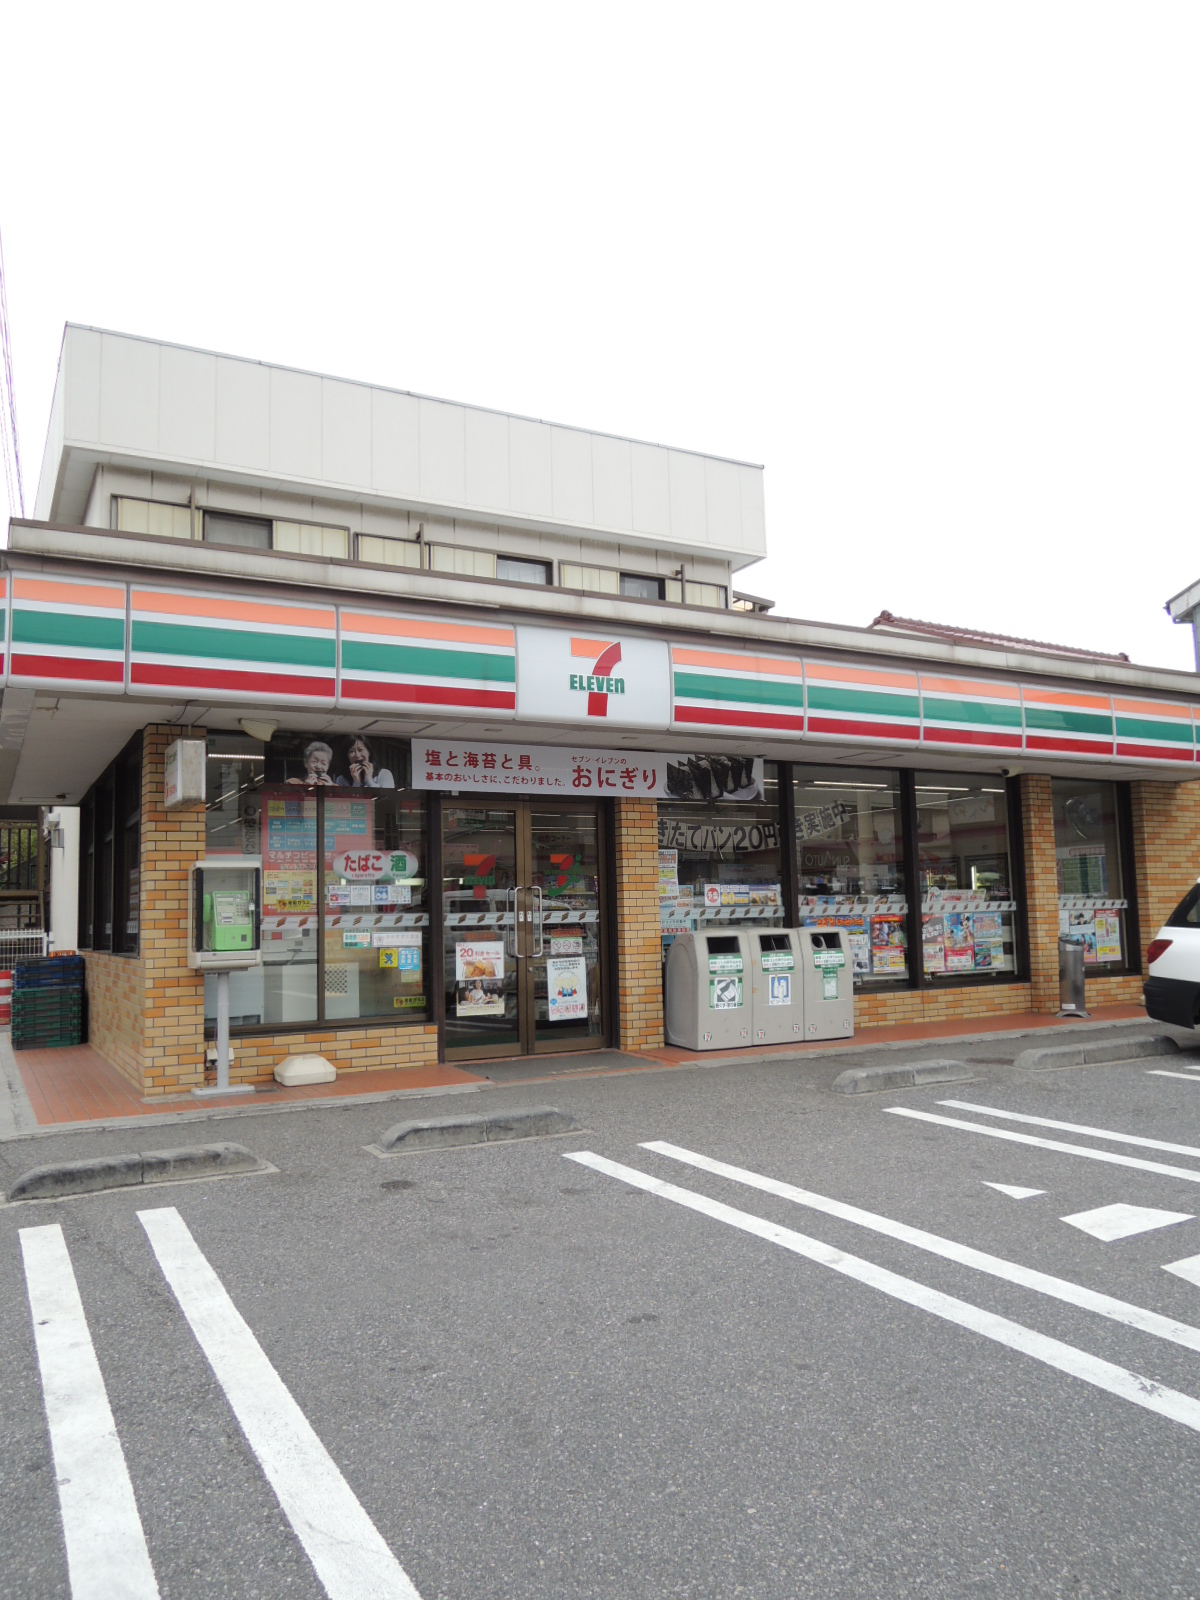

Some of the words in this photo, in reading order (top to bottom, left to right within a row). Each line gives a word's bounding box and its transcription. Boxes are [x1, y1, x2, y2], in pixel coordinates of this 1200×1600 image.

[570, 637, 622, 717] 7
[425, 749, 541, 772] 塩と海苔と具。
[425, 772, 566, 787] 基本のおいしさに、こだわりました。
[572, 765, 657, 790] おにぎり
[344, 853, 383, 872] たばこ
[390, 854, 407, 872] 酒
